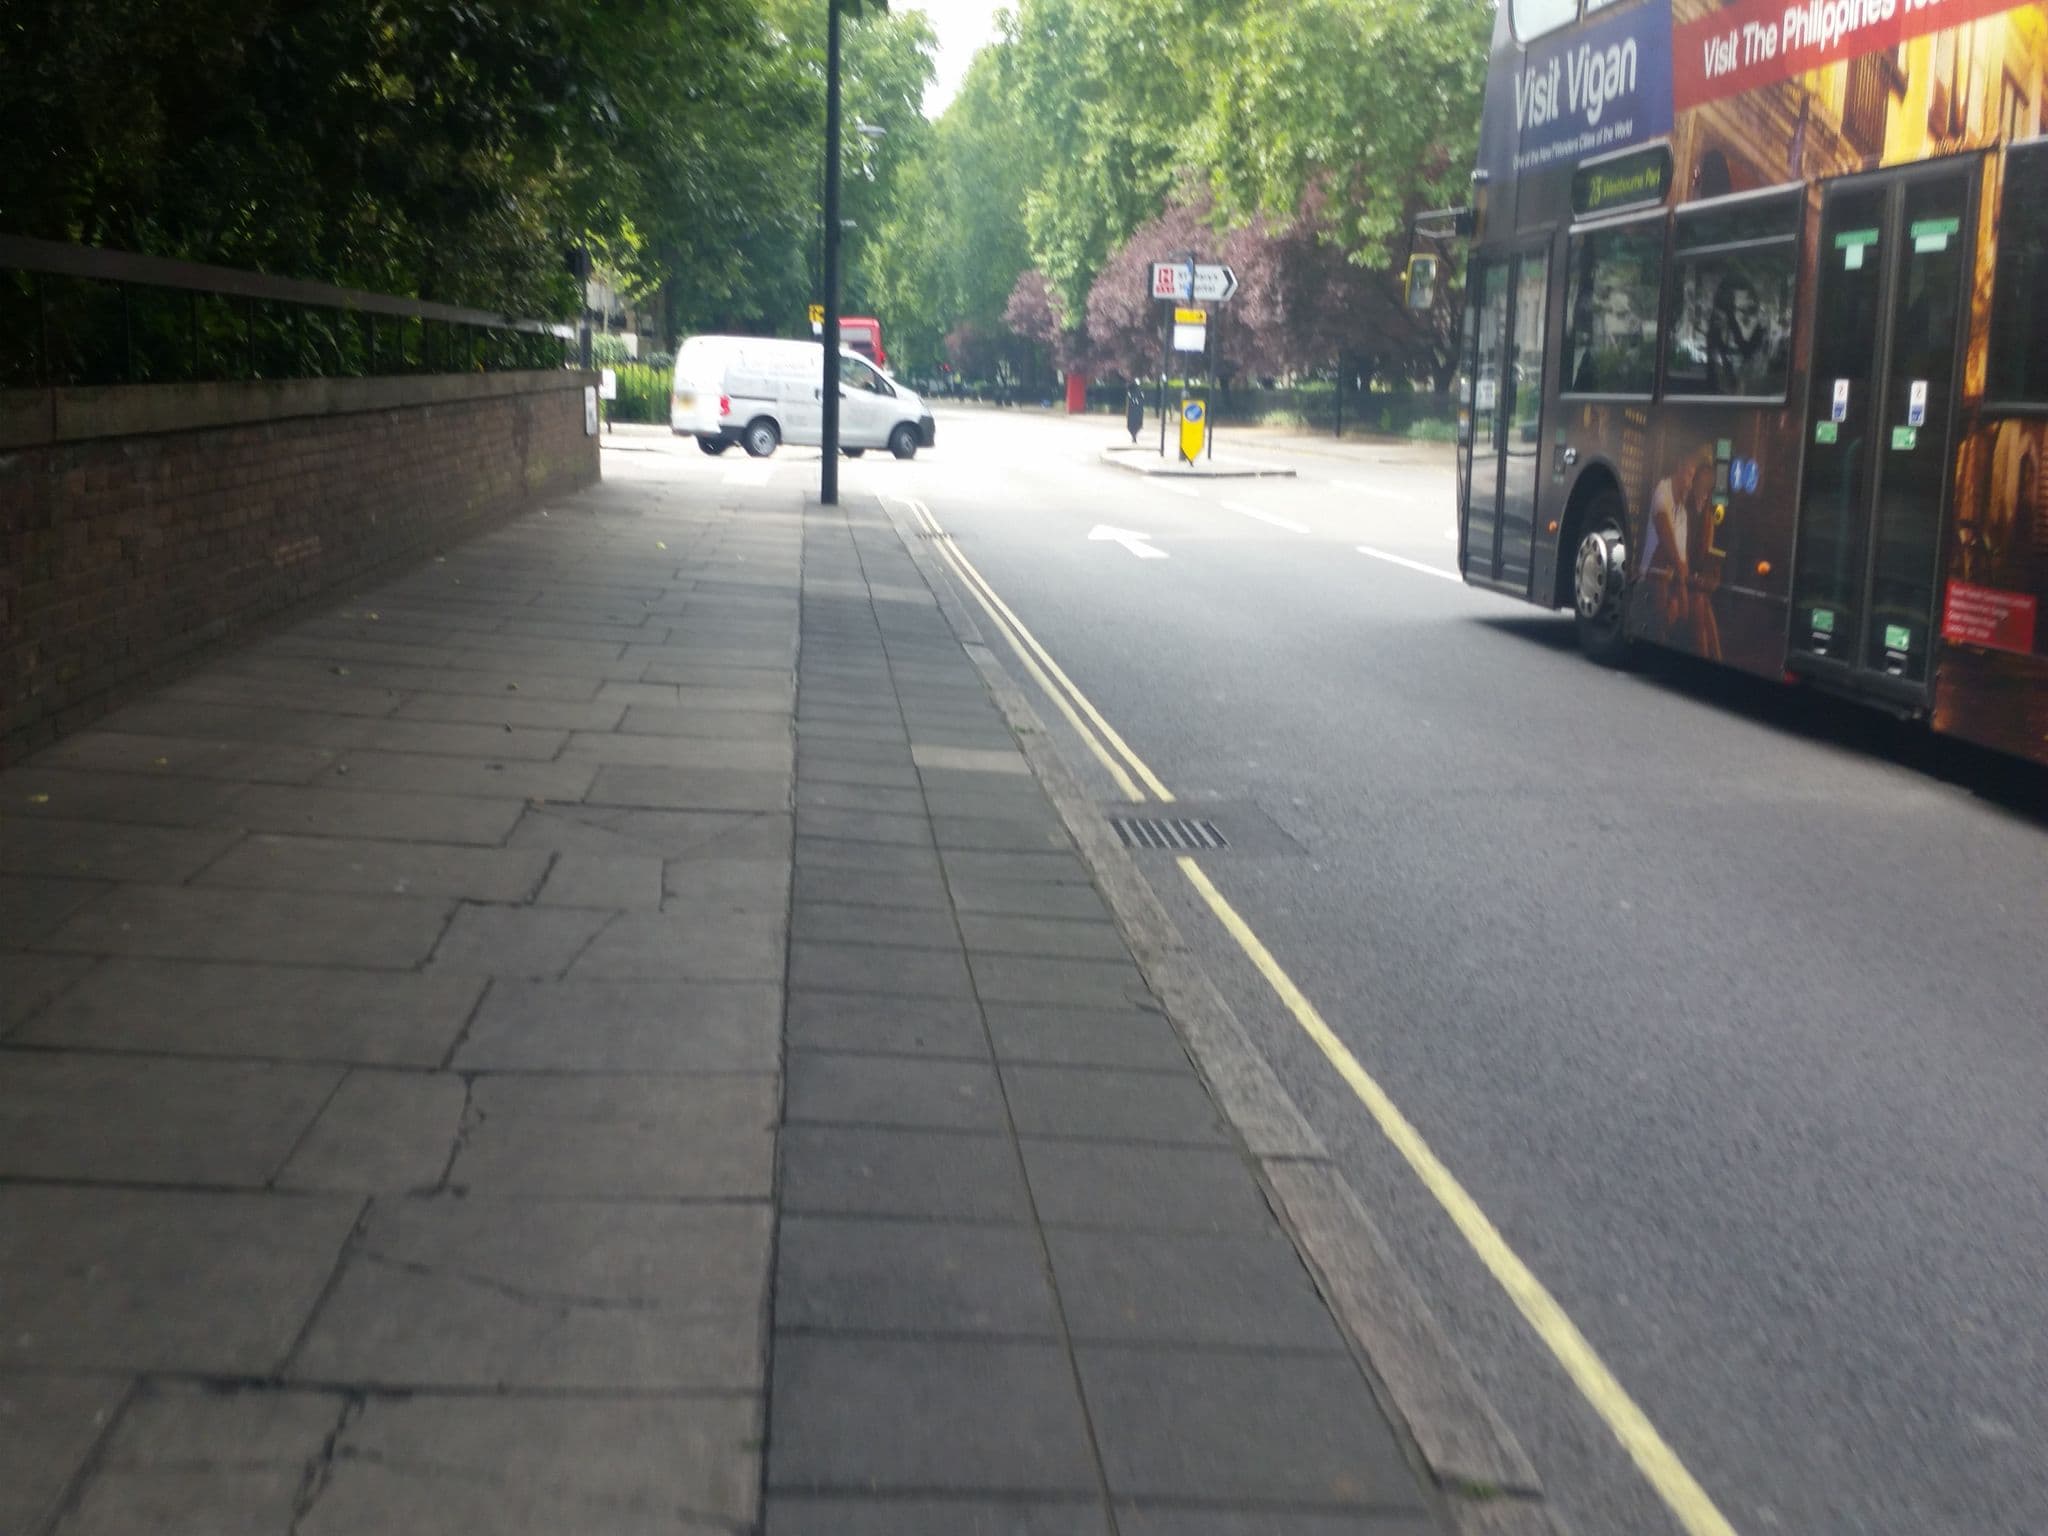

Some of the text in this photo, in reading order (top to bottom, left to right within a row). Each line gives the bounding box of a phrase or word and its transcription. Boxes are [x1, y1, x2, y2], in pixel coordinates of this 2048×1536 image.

[1704, 0, 1896, 79] Visit The Philippines
[1515, 37, 1637, 132] Visit Vigan
